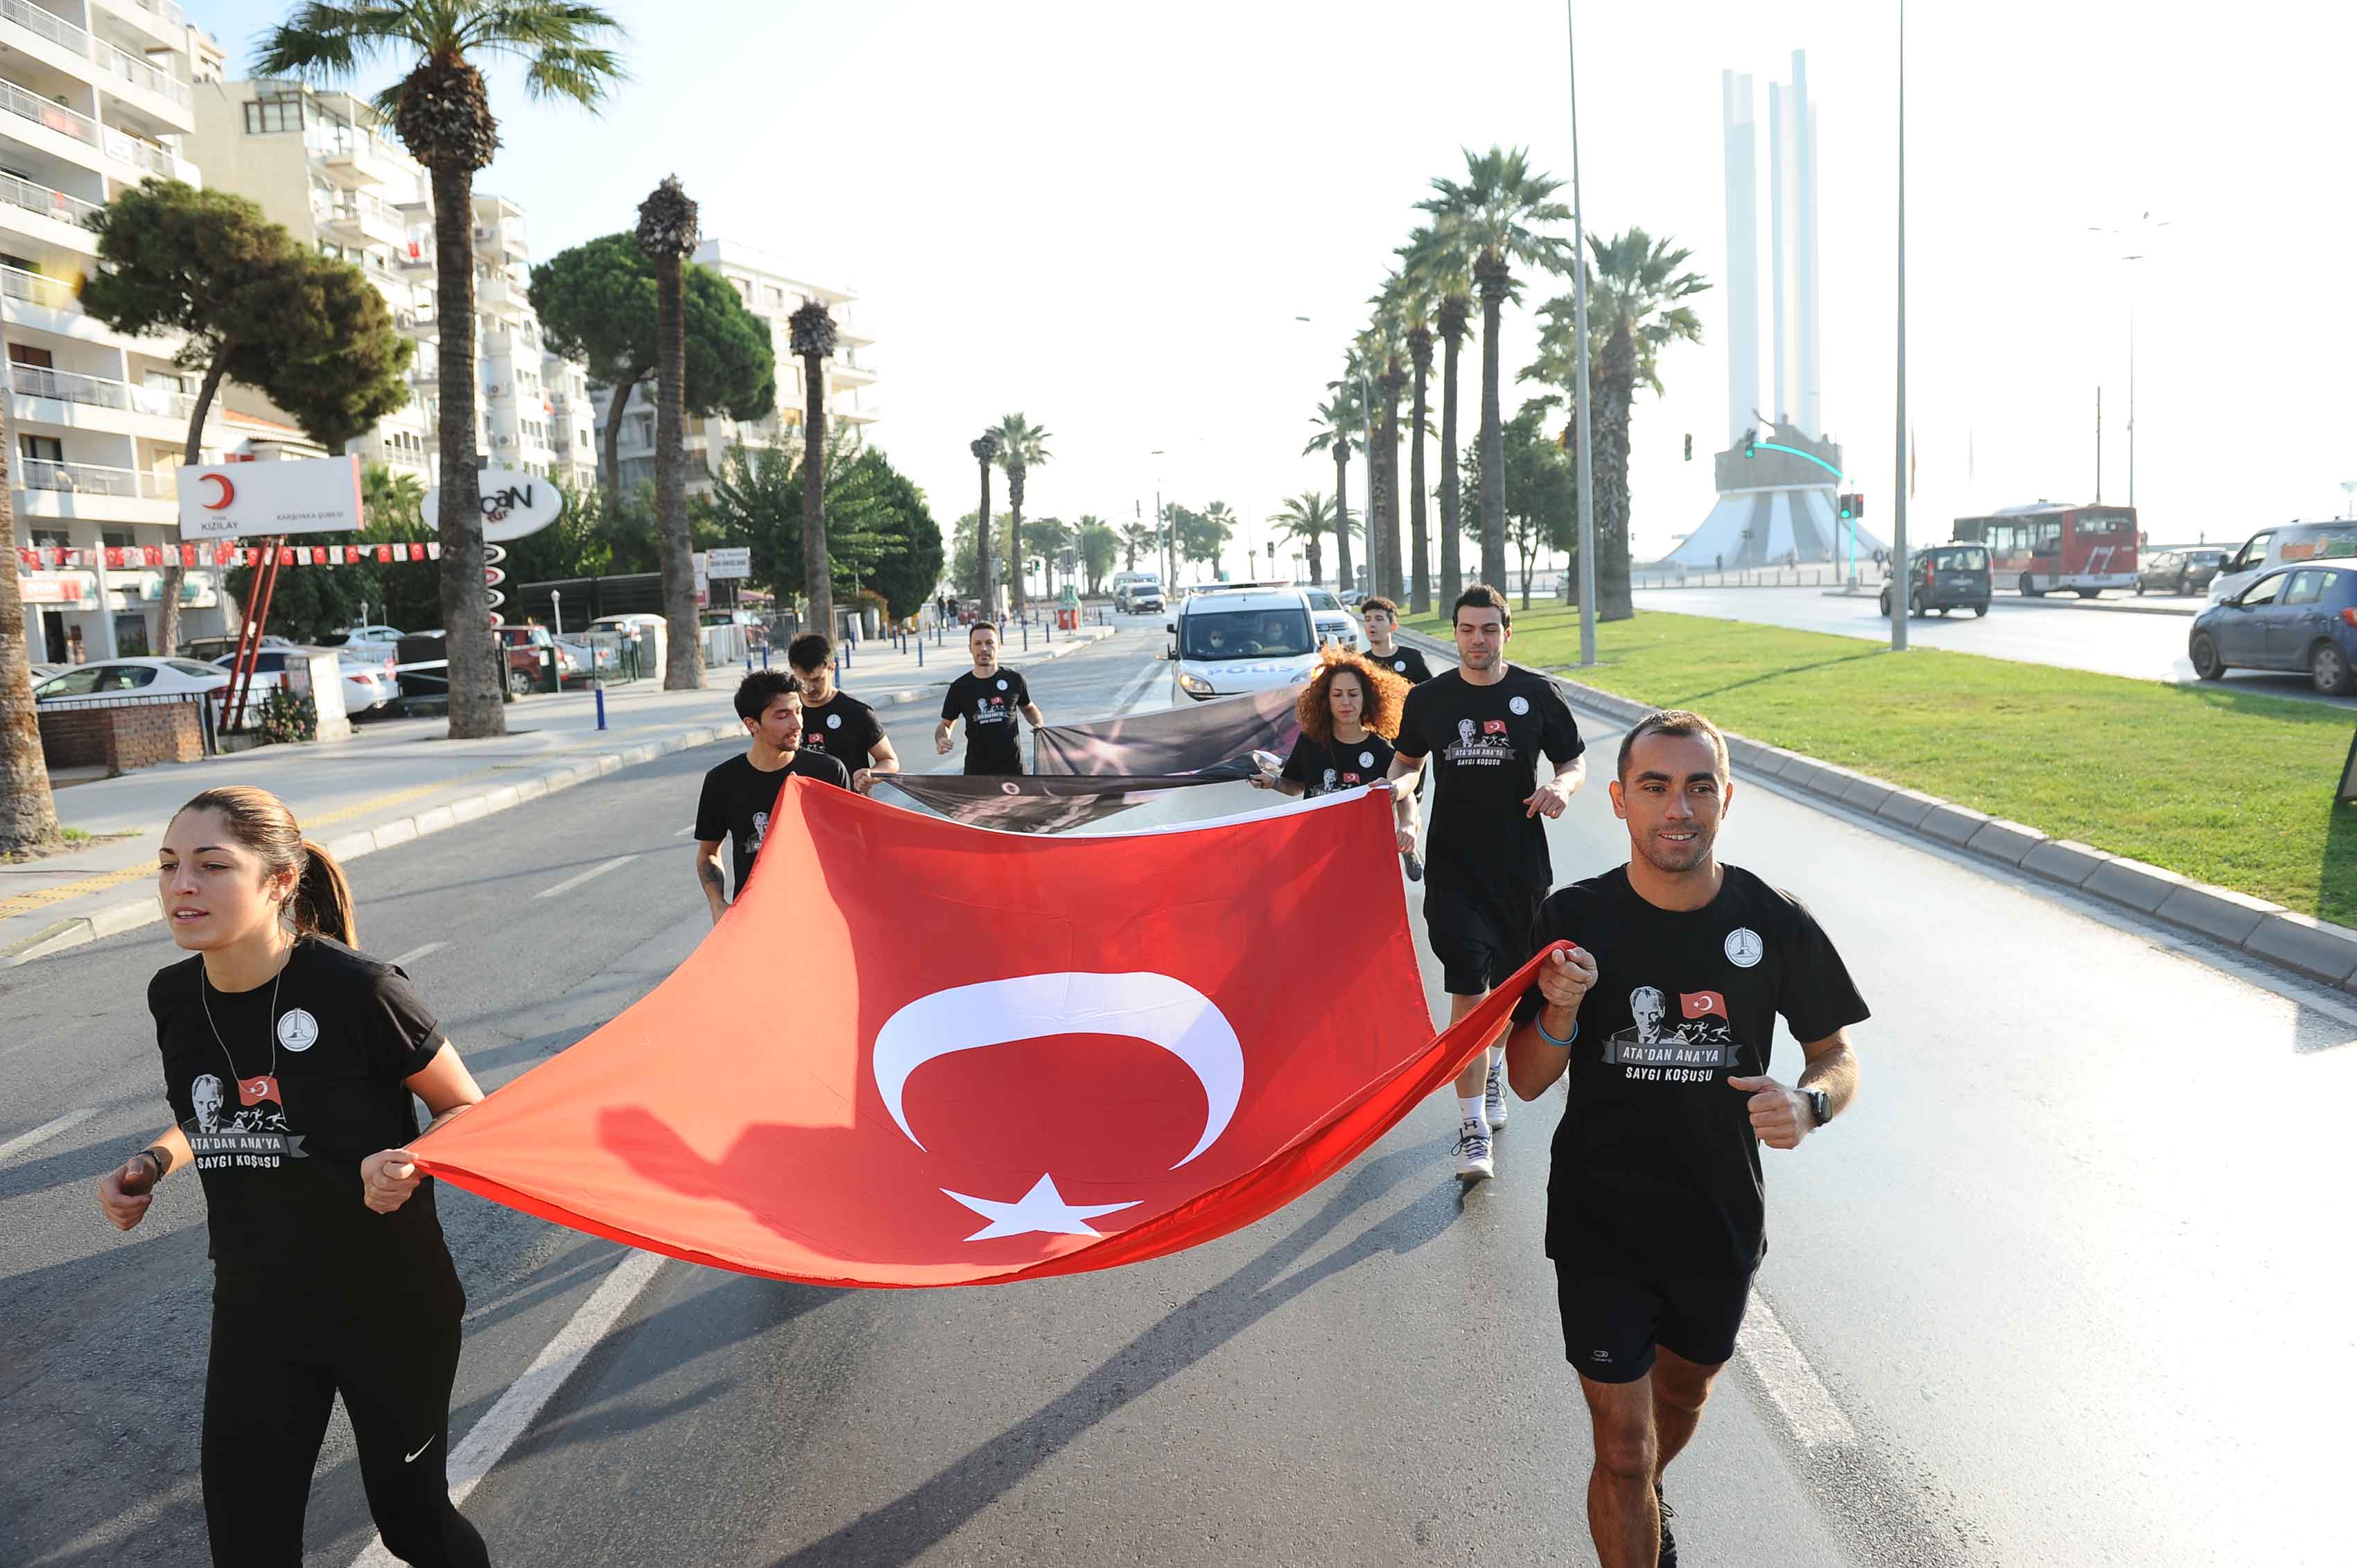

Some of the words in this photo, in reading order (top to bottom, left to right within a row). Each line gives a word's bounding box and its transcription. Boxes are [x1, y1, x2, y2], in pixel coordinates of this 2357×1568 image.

[200, 521, 238, 532] KIZILAY
[1622, 1047, 1672, 1061] ATA'DAN
[1675, 1049, 1719, 1063] ANA'YA
[1626, 1066, 1661, 1081] SAYGI
[1664, 1068, 1713, 1083] KOŞUSU
[191, 1138, 236, 1149] ATA'DAN
[241, 1138, 281, 1149] ANA'YA
[197, 1155, 232, 1169] SAYGI
[236, 1155, 280, 1168] KOŞUSU
